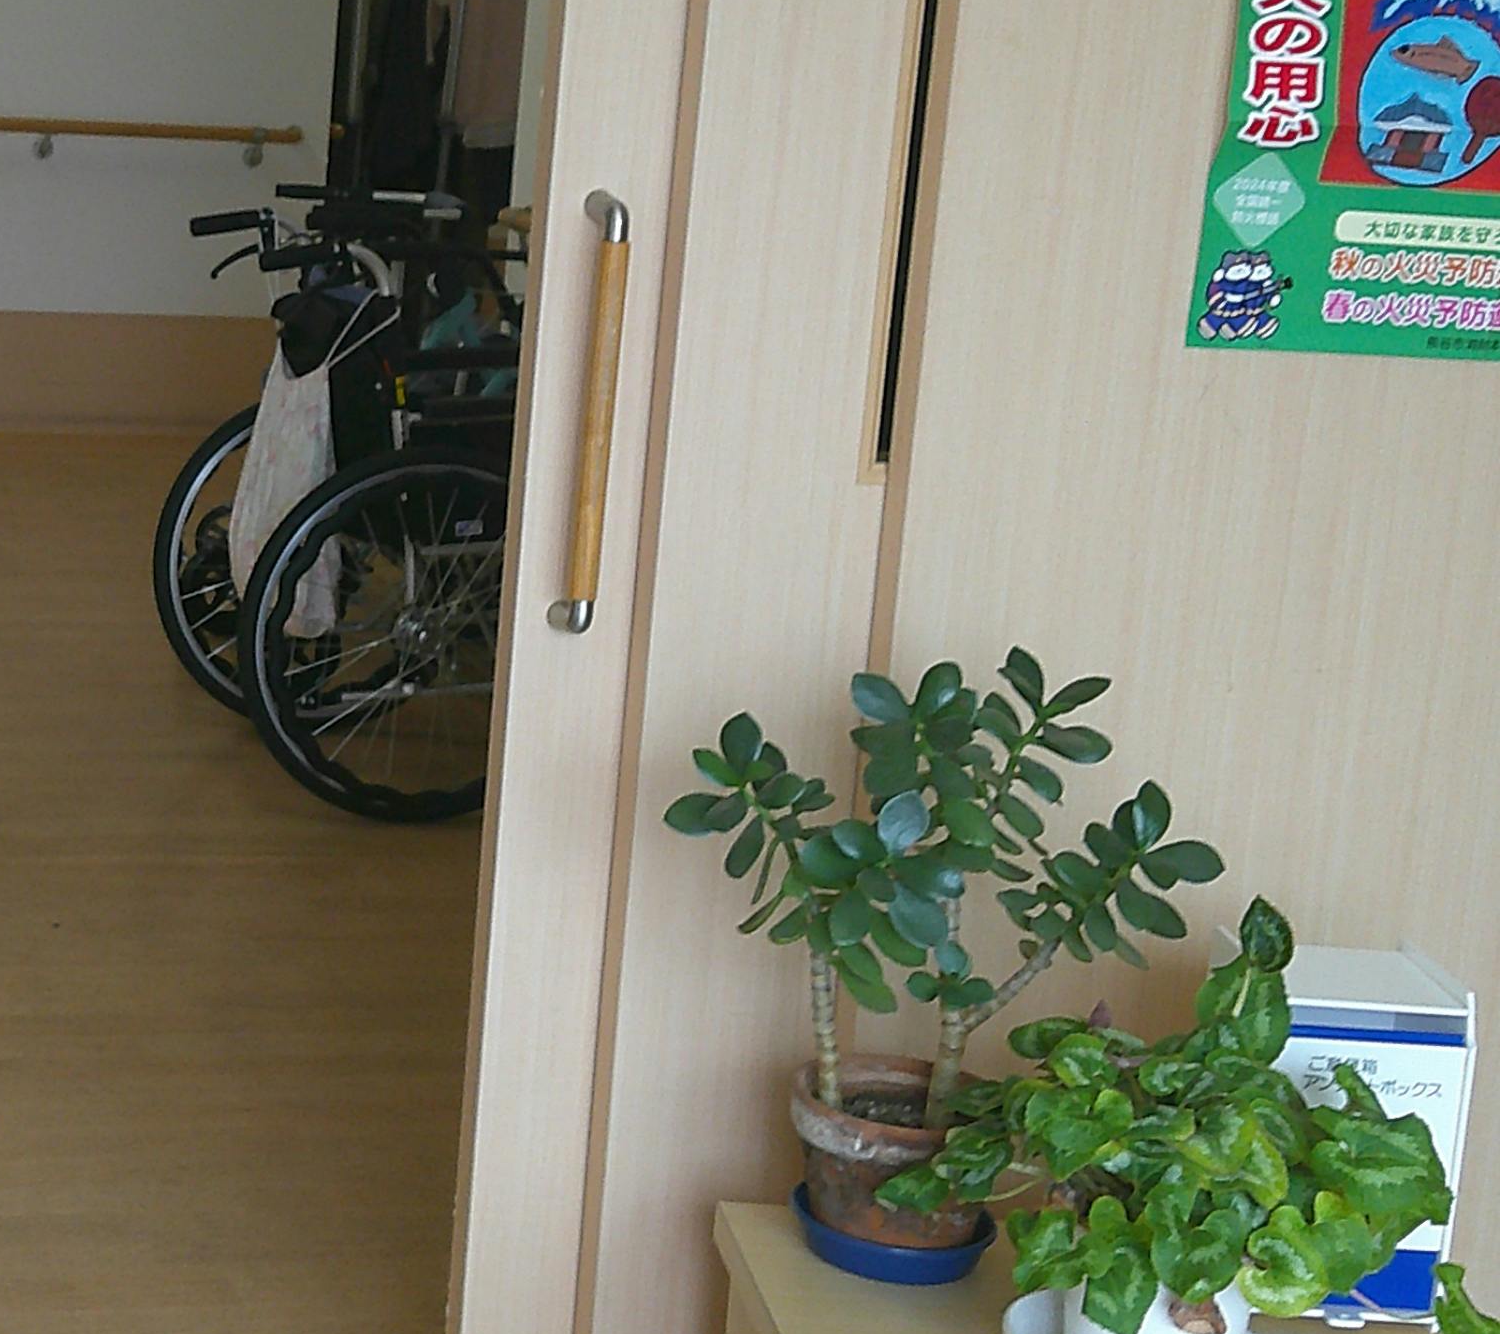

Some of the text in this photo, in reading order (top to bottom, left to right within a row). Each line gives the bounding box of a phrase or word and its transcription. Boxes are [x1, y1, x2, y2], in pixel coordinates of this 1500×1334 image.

[1329, 246, 1500, 289] 秋の火災予防
[1303, 1073, 1442, 1098] アントボックス
